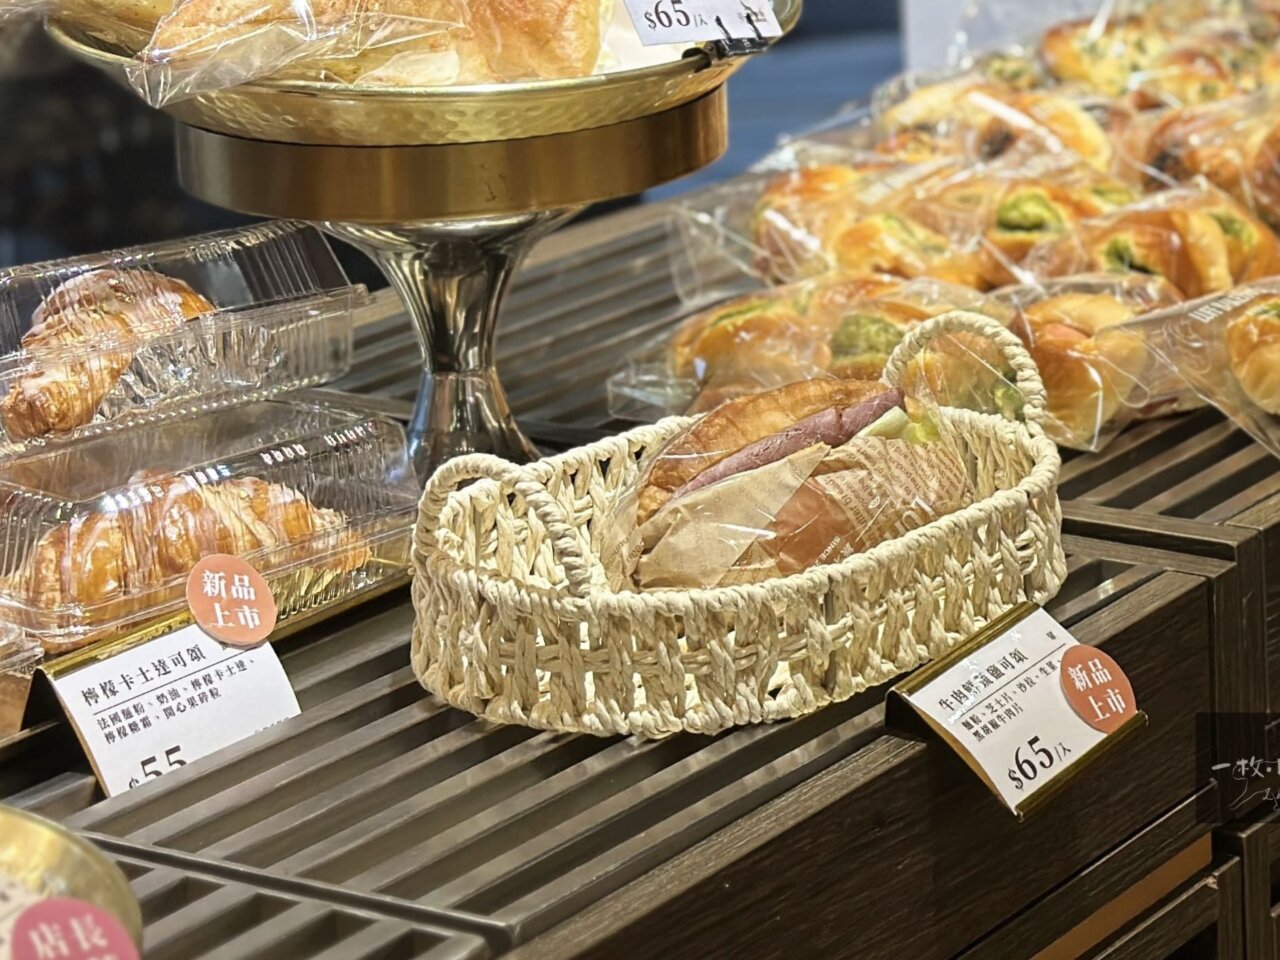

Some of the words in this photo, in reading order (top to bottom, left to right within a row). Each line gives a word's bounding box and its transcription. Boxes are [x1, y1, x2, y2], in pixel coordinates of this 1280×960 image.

[201, 569, 256, 601] 新品
[209, 601, 262, 629] 上市
[80, 643, 206, 708] 檸檬卡士達可頌
[1067, 658, 1113, 692] 新品
[1088, 687, 1127, 723] 上市
